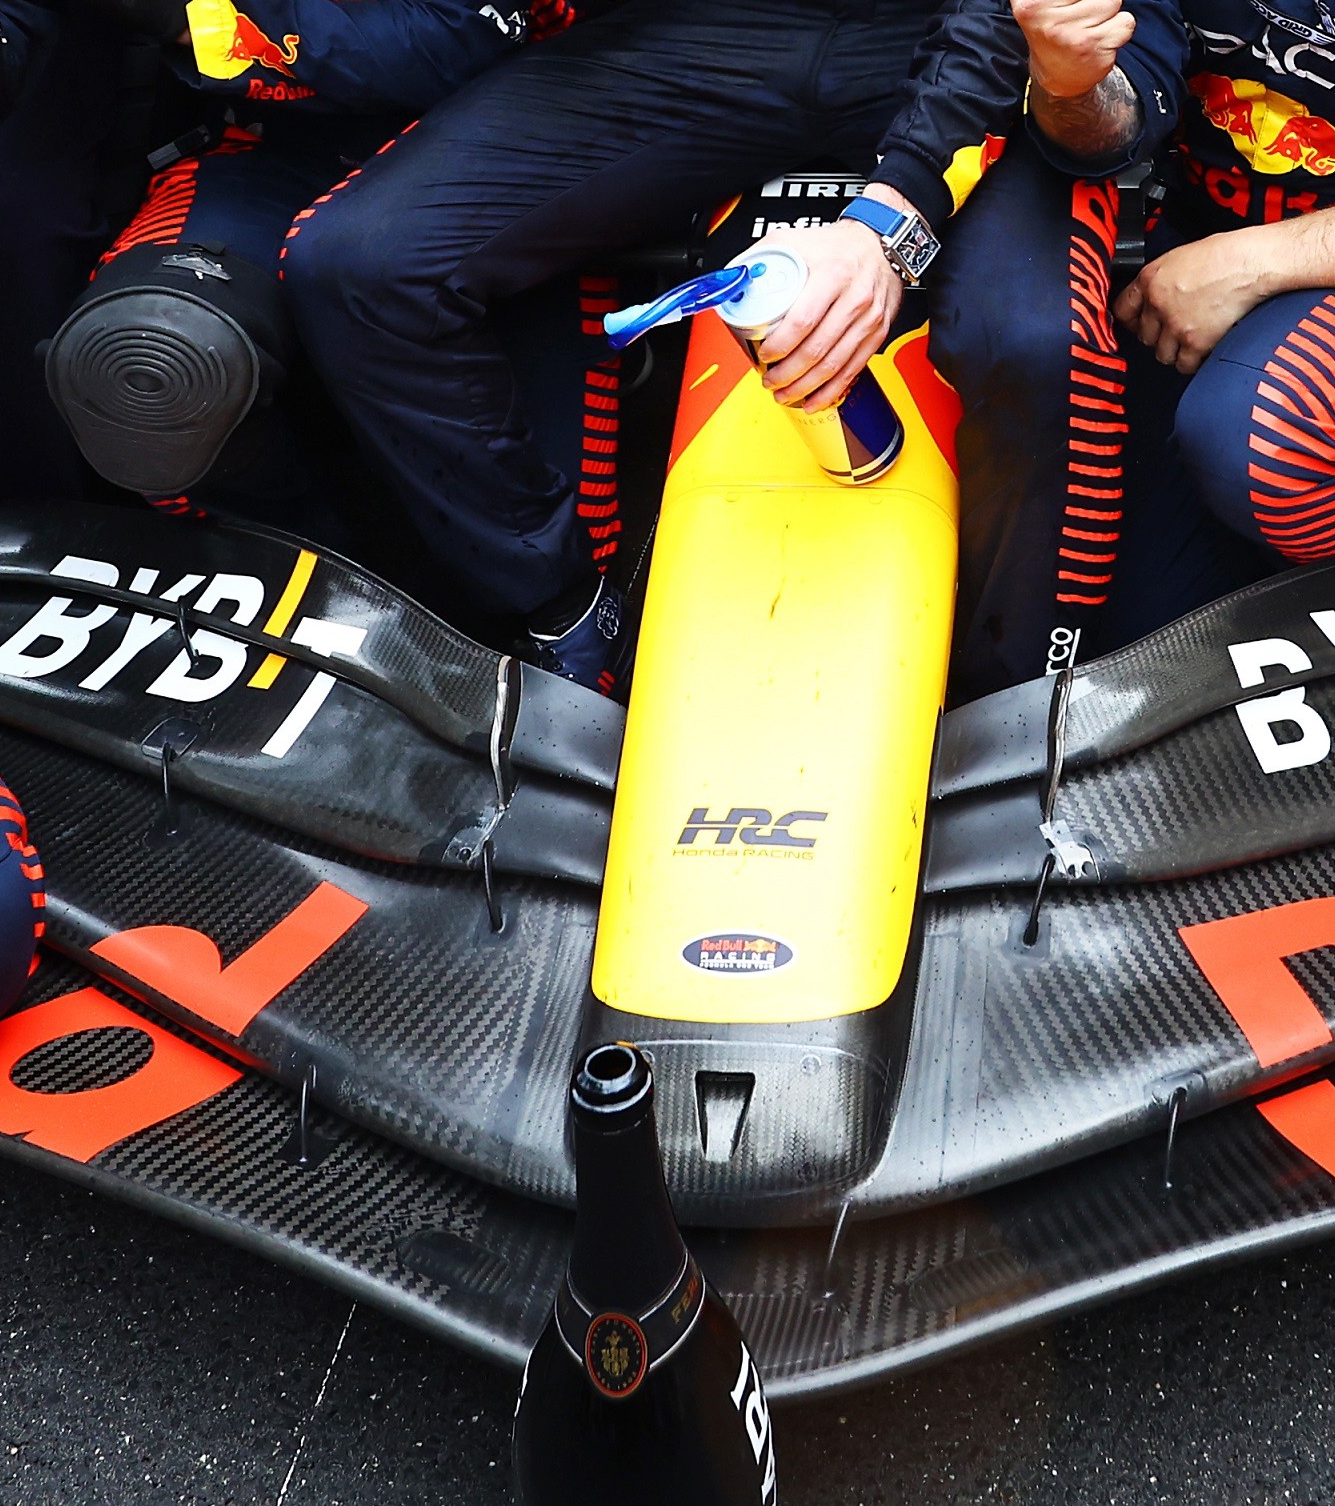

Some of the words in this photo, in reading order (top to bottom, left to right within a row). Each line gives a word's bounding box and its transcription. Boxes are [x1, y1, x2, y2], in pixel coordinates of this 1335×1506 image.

[677, 807, 829, 848] HRC
[672, 847, 739, 857] Honda
[742, 848, 815, 861] RACING
[701, 940, 721, 952] Red
[722, 940, 743, 952] Bull
[700, 951, 775, 962] RACING
